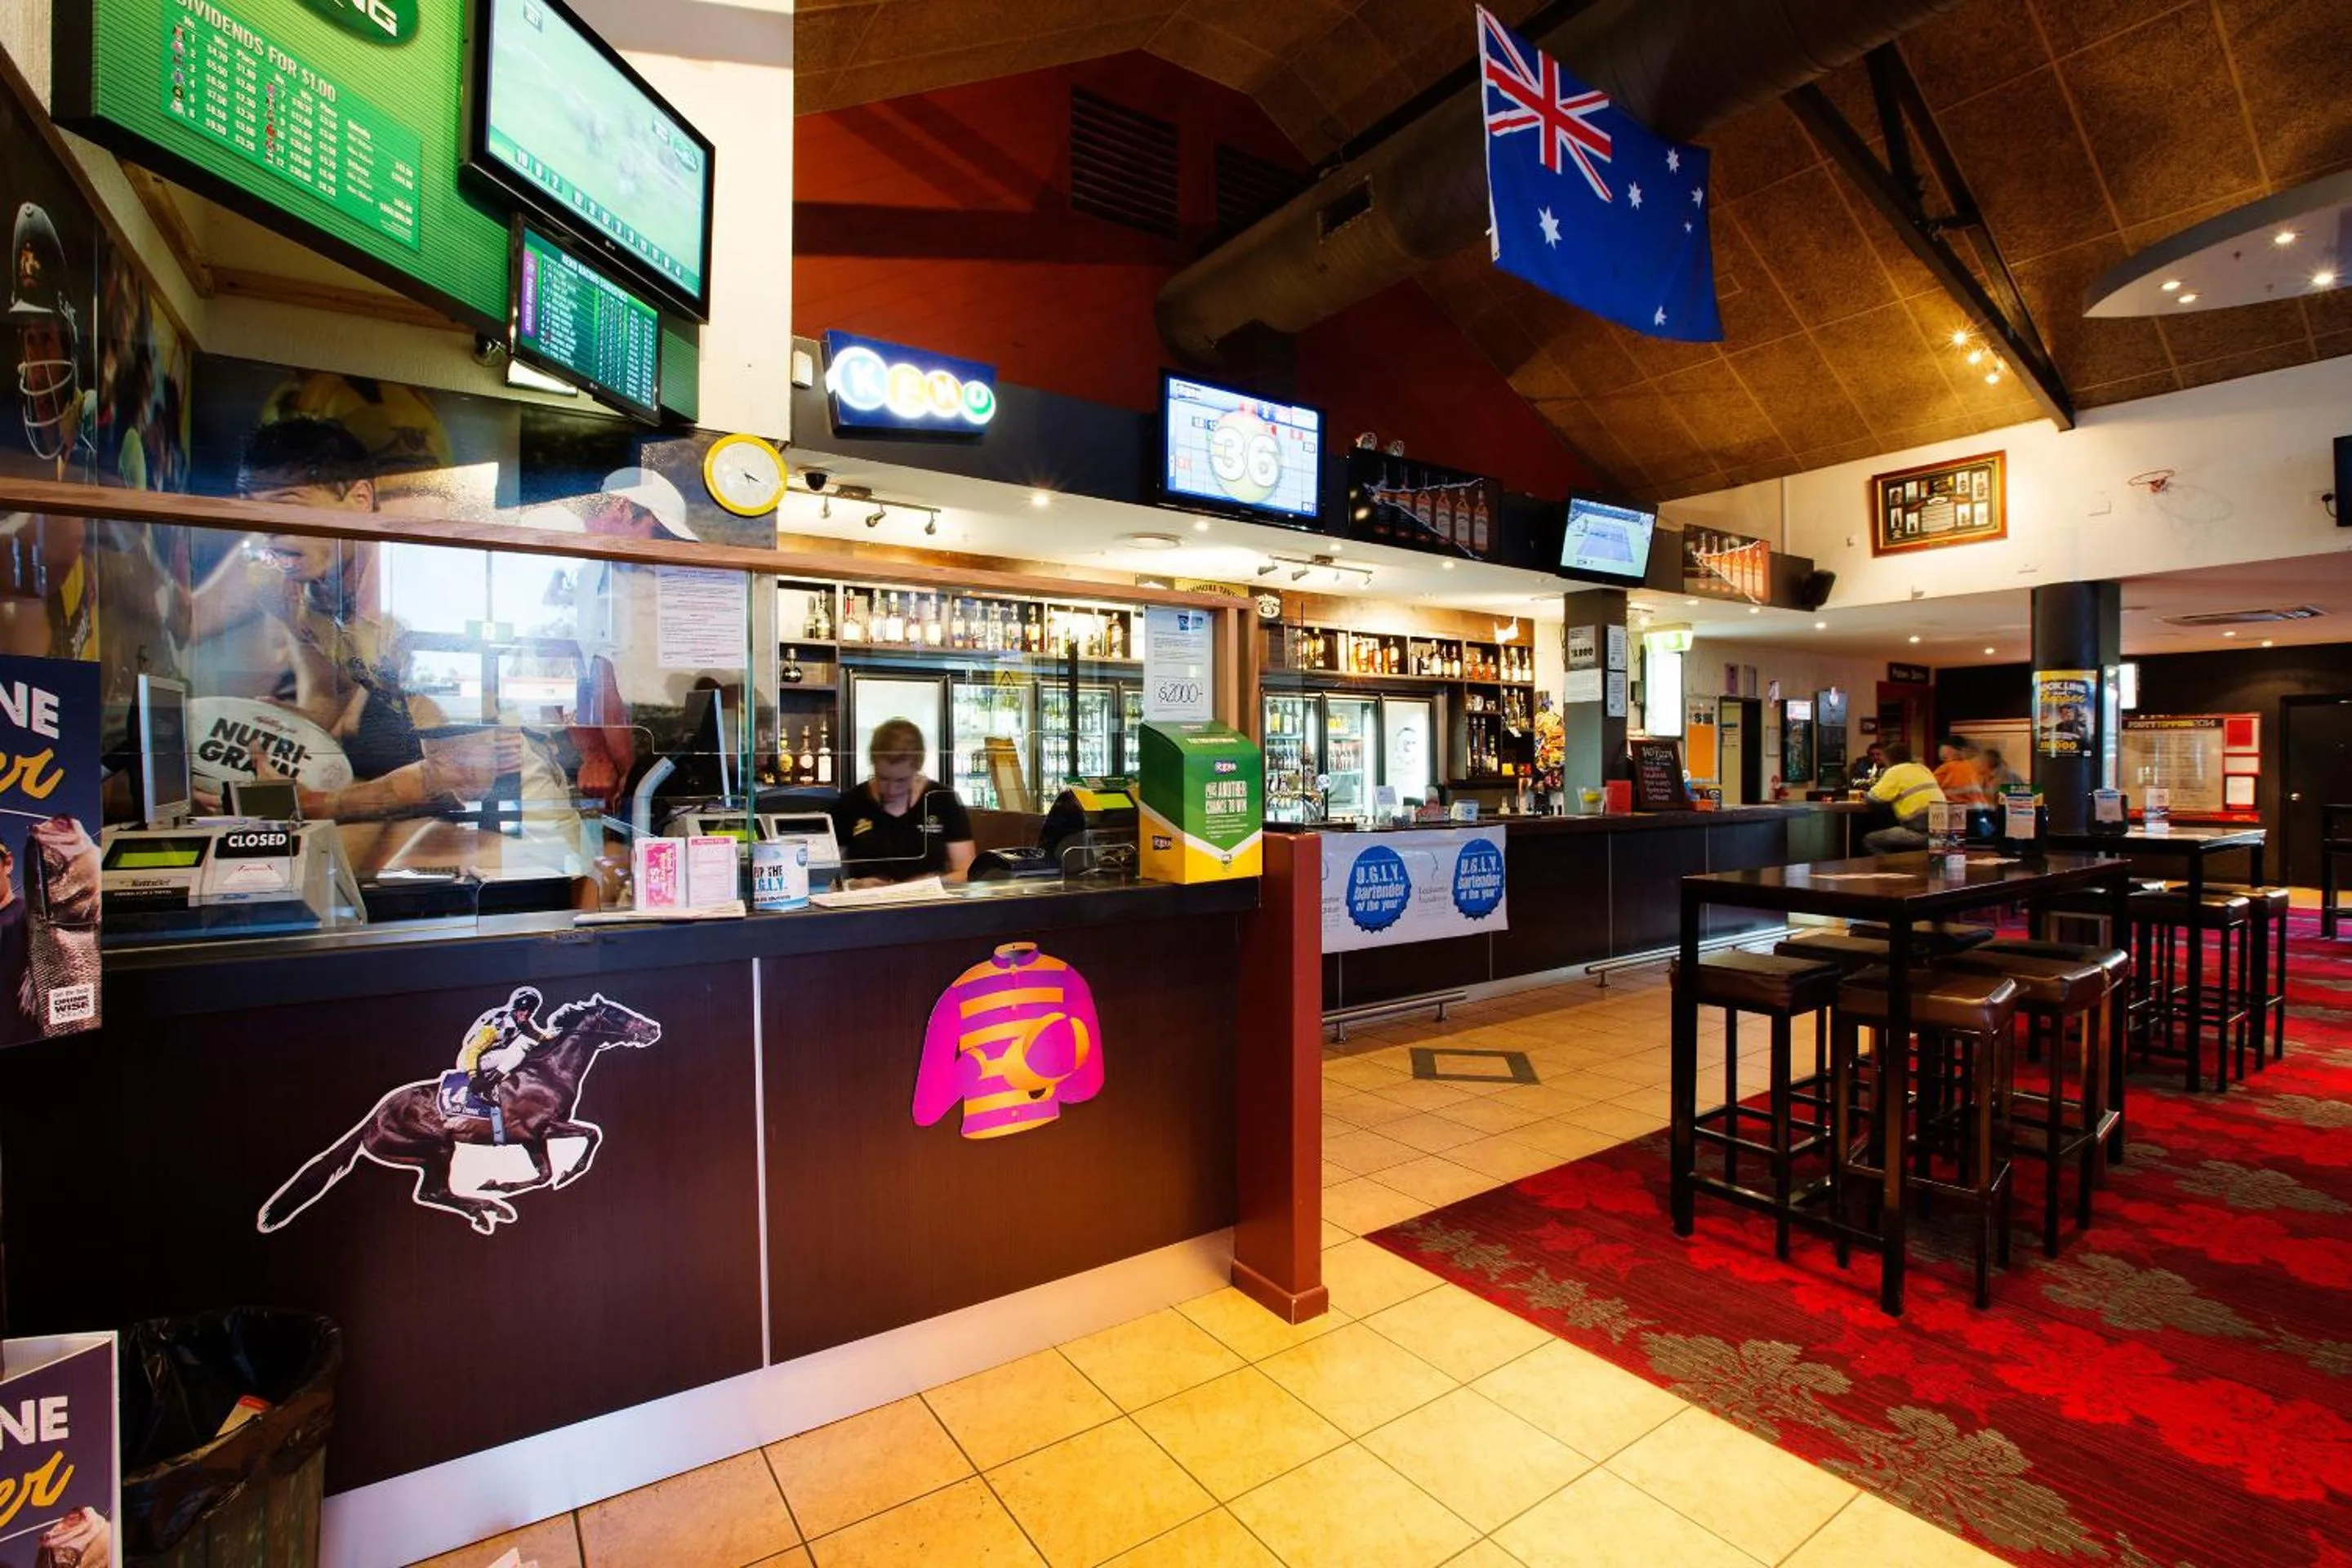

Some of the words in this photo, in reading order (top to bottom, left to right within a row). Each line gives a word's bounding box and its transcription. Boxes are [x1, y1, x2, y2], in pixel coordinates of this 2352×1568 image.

[268, 45, 296, 79] FOR
[301, 68, 336, 102] $1.00
[836, 351, 993, 416] KENO
[1210, 425, 1281, 488] 36
[228, 832, 287, 849] CLOSED
[1356, 862, 1404, 885] U.G.L.Y.
[1461, 855, 1500, 874] U.G.L.Y.
[1353, 882, 1404, 901] bartender
[1356, 901, 1365, 911] of
[1366, 899, 1379, 911] the
[55, 1001, 90, 1013] WISE
